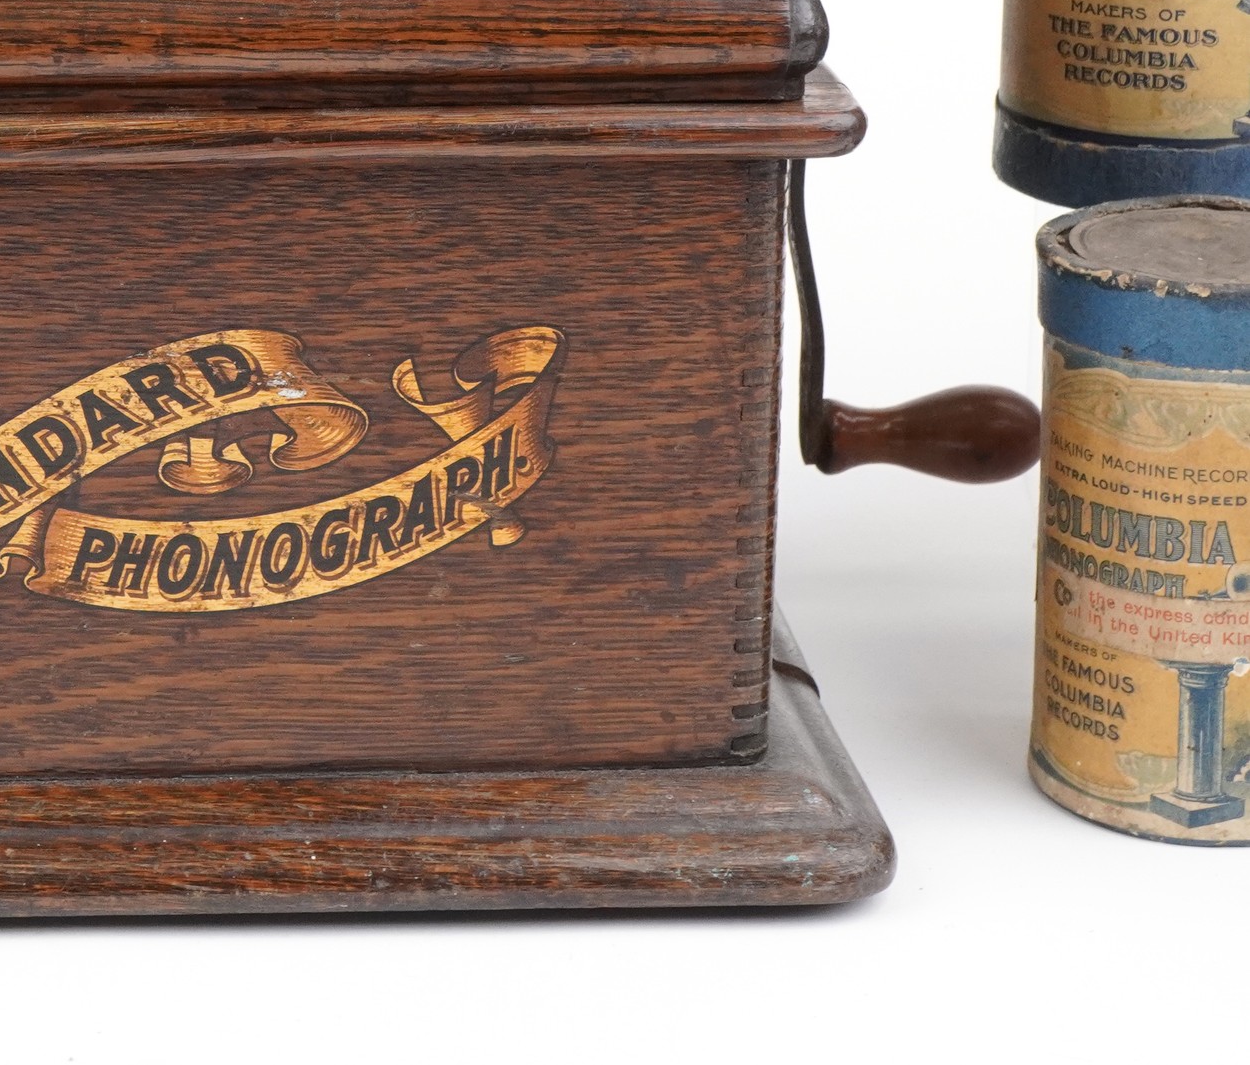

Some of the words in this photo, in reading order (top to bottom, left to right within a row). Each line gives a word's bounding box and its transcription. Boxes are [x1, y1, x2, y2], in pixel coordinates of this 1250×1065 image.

[1071, 0, 1148, 20] MAKERS
[1158, 9, 1187, 22] OF
[1049, 13, 1094, 39] THE
[1100, 23, 1220, 47] FAMOUS
[1056, 39, 1199, 70] COLUMBIA
[1064, 63, 1187, 93] RECORDS
[1101, 453, 1178, 480] MACHINE
[1088, 590, 1116, 610] the
[1124, 602, 1193, 625] express
[1110, 617, 1139, 636] the
[1149, 627, 1212, 645] United
[1102, 652, 1117, 662] OF
[1062, 655, 1136, 694] FAMOUS
[1045, 668, 1126, 720] COLUMBIA
[1047, 695, 1121, 741] RECORDS
